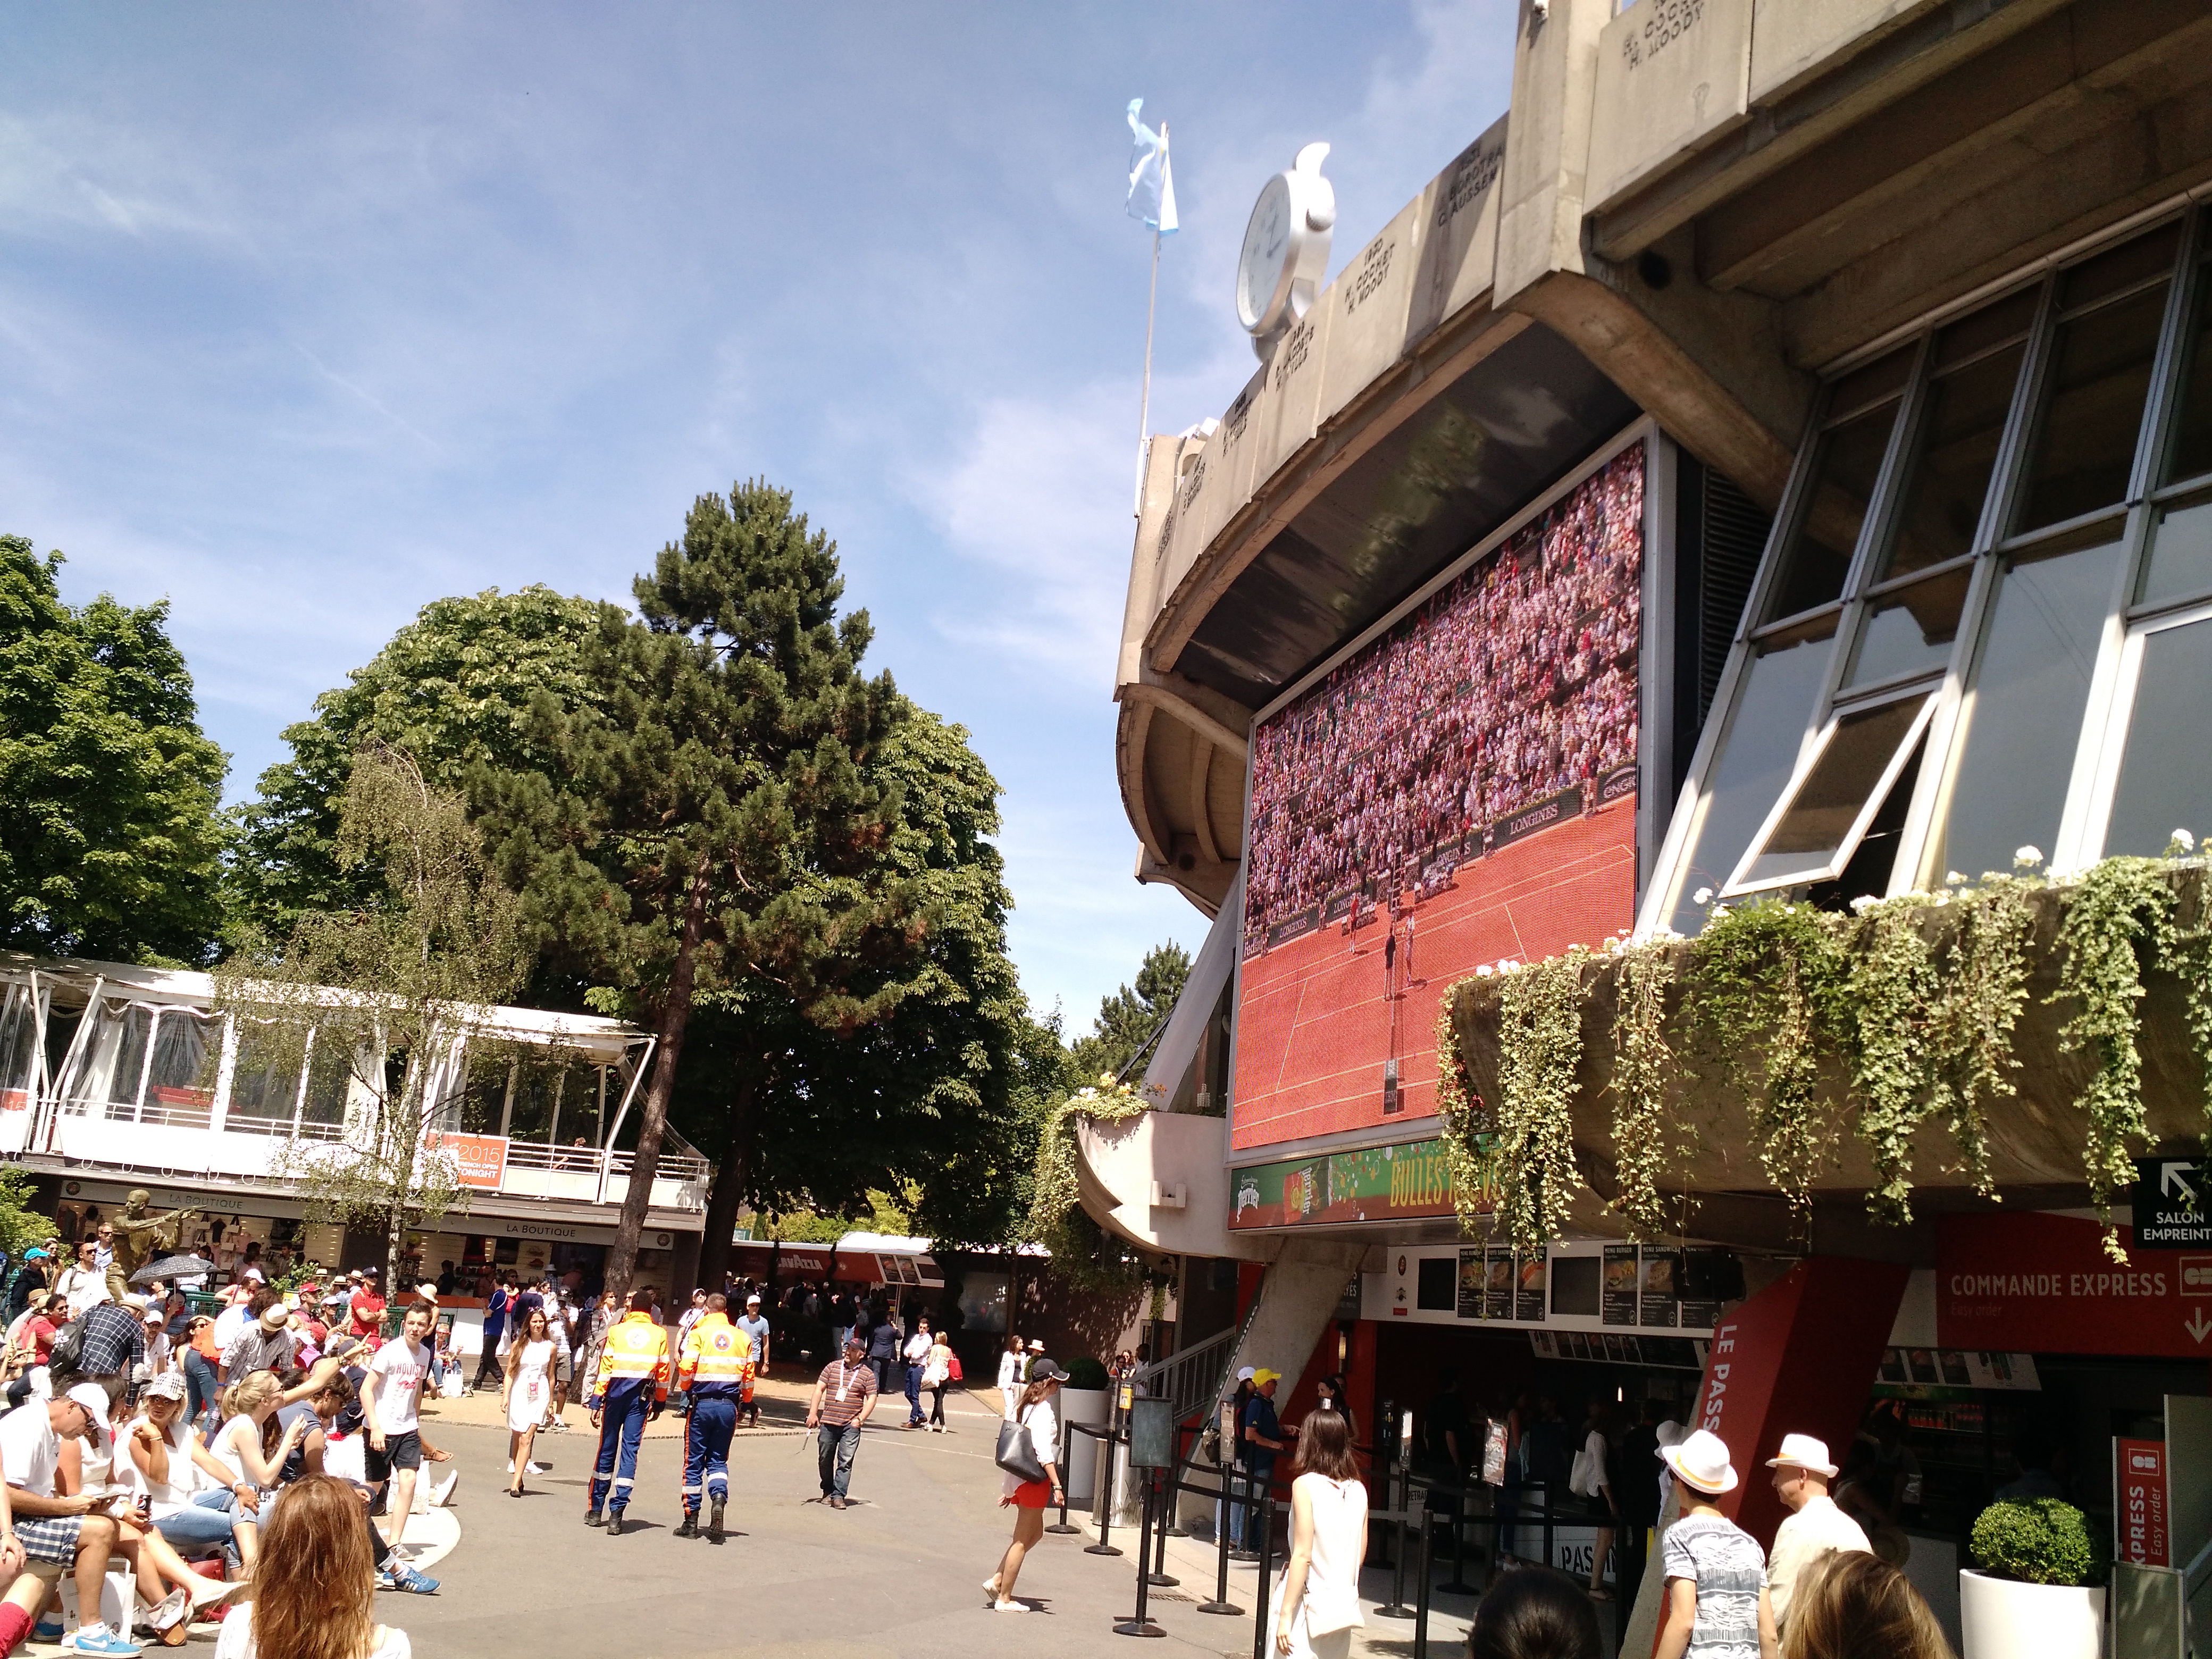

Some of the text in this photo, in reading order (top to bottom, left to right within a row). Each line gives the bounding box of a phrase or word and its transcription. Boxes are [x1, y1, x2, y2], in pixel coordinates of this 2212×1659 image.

[1356, 242, 1395, 292] COCHET
[1358, 263, 1390, 307] MOODY
[1510, 802, 1559, 835] LONGINES
[459, 1145, 500, 1162] 2015
[457, 1168, 498, 1178] TONIGHT
[1390, 1156, 1443, 1207] BULLES
[170, 1194, 243, 1209] LA BOUTIQUE
[2156, 1212, 2204, 1224] SALON
[522, 1225, 576, 1237] BOUTIQUE
[2143, 1228, 2212, 1240] EMPREINT
[1951, 1272, 2167, 1296] COMMANDE EXPRESS
[1951, 1302, 2002, 1317] Easy order
[1703, 1325, 1738, 1436] LE PASS
[2129, 1485, 2146, 1565] XPRESS
[2149, 1487, 2165, 1556] Easy order
